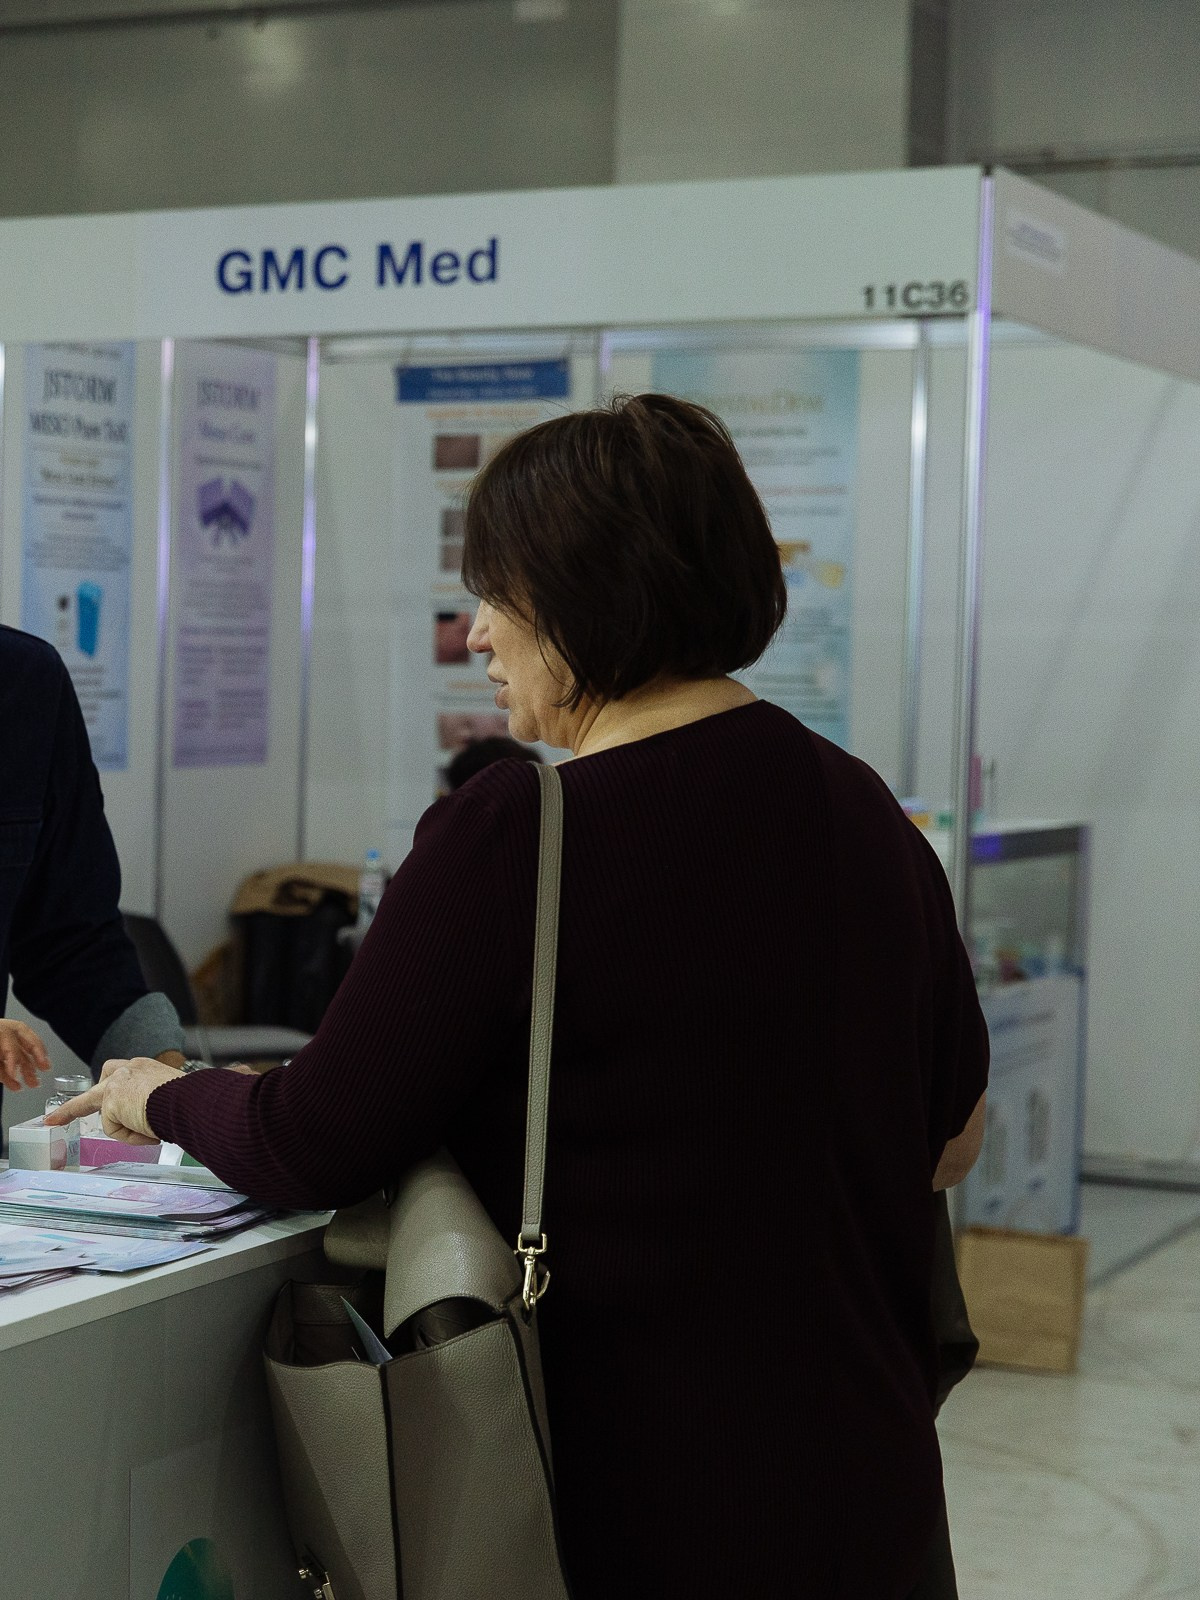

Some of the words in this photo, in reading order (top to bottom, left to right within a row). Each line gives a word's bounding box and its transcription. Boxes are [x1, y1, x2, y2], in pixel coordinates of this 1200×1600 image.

[216, 244, 349, 294] GMC
[376, 236, 499, 287] Med
[862, 279, 969, 309] 11C36
